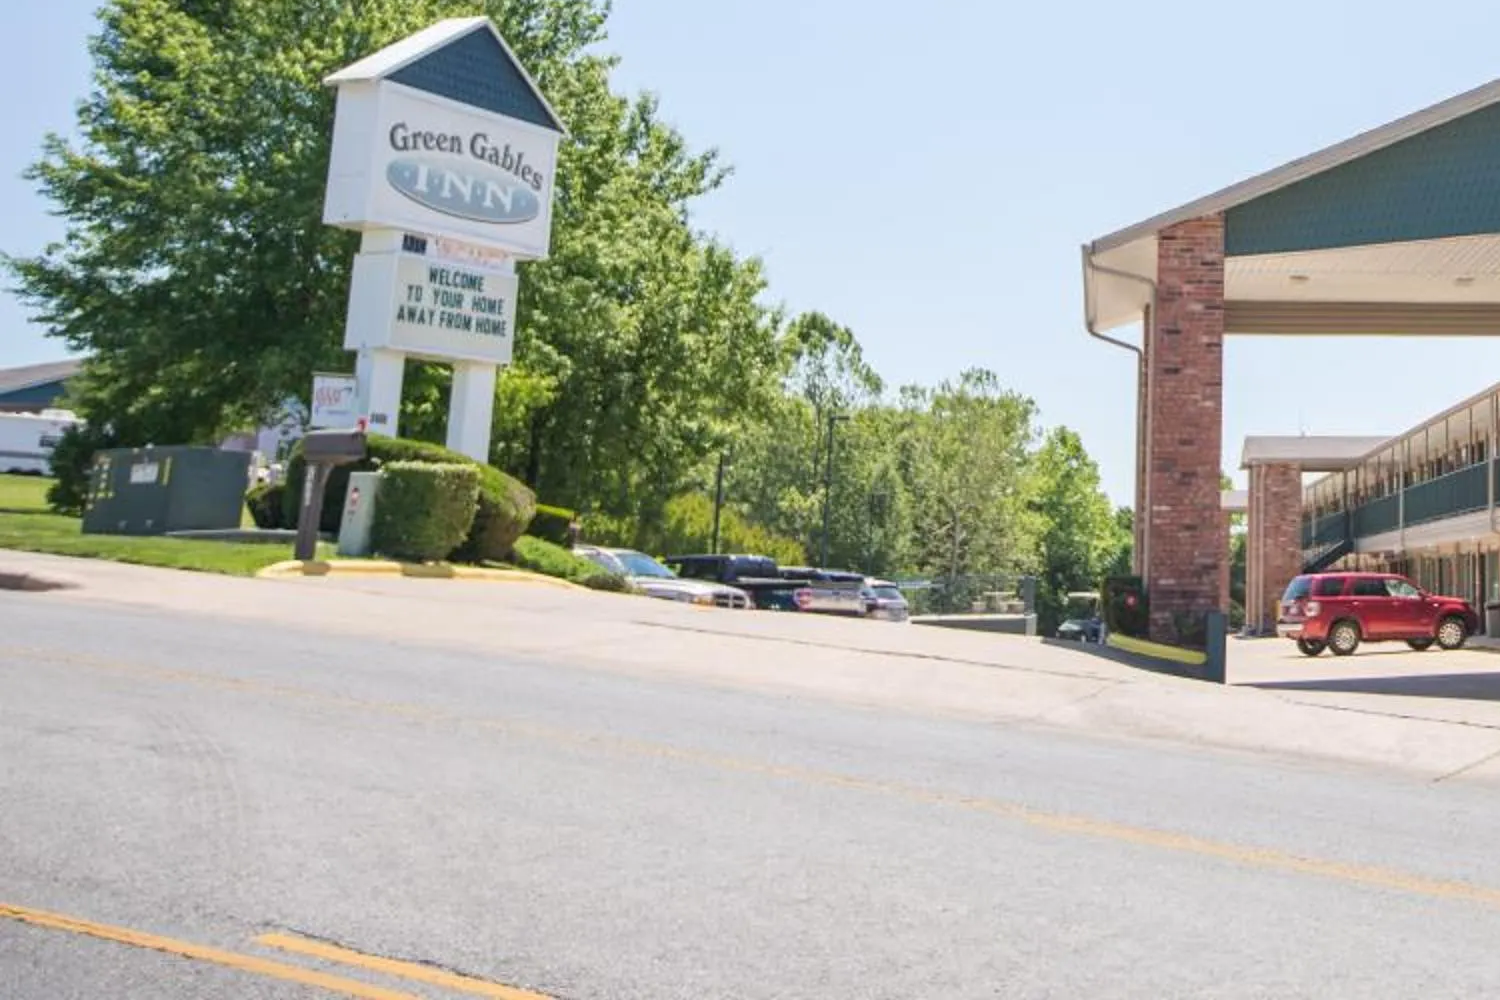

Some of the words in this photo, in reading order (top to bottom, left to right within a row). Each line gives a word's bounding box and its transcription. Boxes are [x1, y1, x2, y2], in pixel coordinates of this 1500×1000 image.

[389, 121, 464, 154] Green
[470, 132, 543, 191] Gables
[414, 164, 514, 213] INN
[429, 266, 484, 292] WELCOME
[407, 284, 423, 302] TO
[433, 287, 464, 308] YOUR
[471, 295, 504, 315] HOME
[397, 303, 436, 326] AWAY
[439, 309, 472, 332] FROM
[475, 315, 506, 337] HOME
